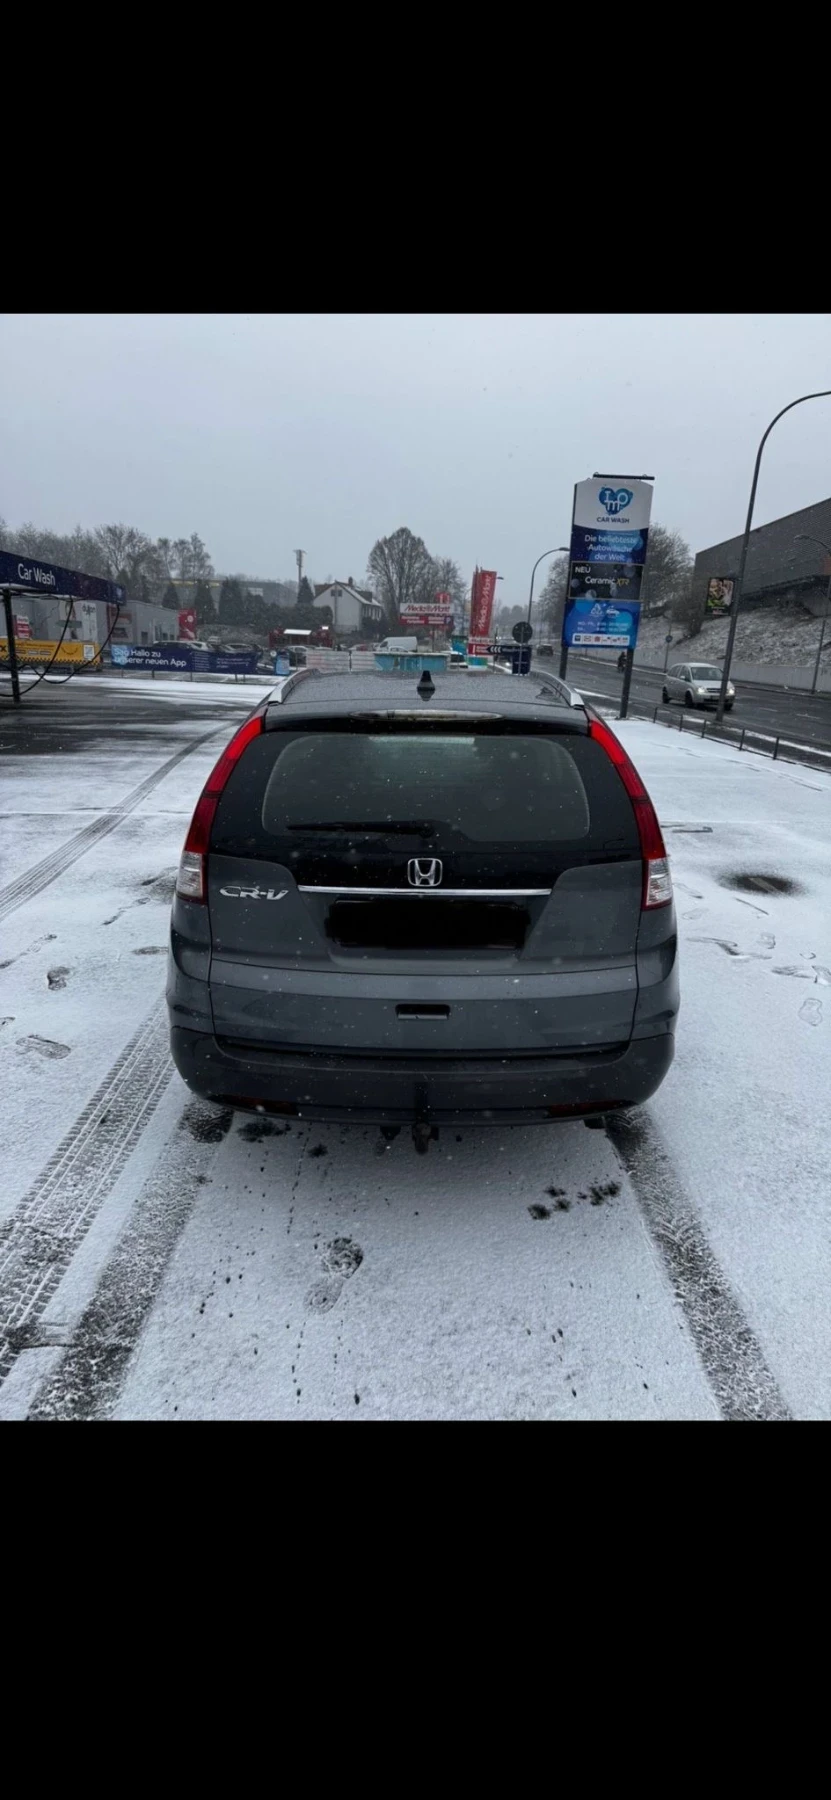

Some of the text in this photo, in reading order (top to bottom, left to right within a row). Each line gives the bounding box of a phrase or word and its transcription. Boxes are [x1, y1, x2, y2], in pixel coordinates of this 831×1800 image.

[584, 534, 597, 542] Die
[594, 552, 625, 561] der Welt
[17, 562, 56, 586] Car Wash
[574, 566, 591, 574] NEU
[584, 575, 616, 585] Ceramic
[130, 648, 150, 657] Hallo
[151, 650, 161, 658] zu
[145, 658, 169, 666] neuen
[170, 658, 187, 668] App
[219, 885, 289, 900] CR-V
